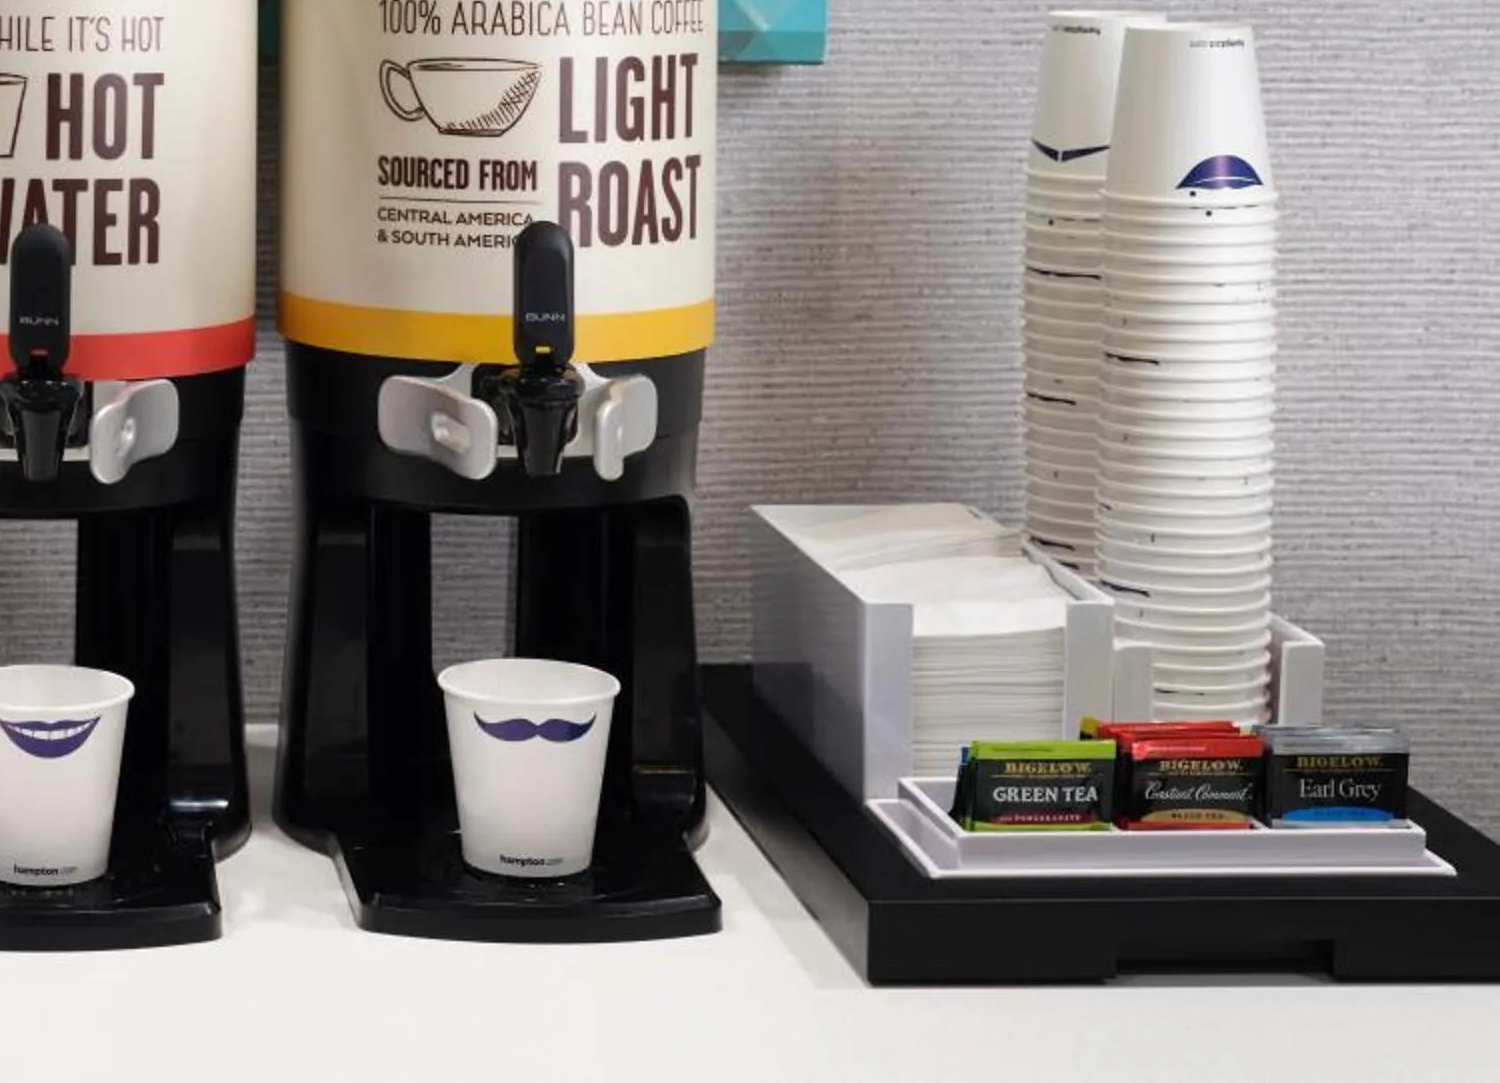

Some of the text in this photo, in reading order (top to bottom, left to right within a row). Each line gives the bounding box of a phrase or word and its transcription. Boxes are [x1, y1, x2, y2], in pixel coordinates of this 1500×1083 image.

[451, 0, 570, 37] ARABICA
[582, 0, 643, 36] BEAN
[68, 15, 111, 53] IT'S
[121, 15, 165, 53] HOT
[558, 52, 698, 143] LIGHT
[45, 72, 165, 160] HOT
[377, 154, 537, 192] SOURCED FROM
[557, 154, 701, 248] ROAST
[377, 207, 534, 227] CENTRAL AMERICA
[377, 228, 389, 244] &
[391, 229, 450, 247] SOUTH
[524, 312, 566, 323] BUNN
[1004, 761, 1092, 775] BIGELOW
[1159, 760, 1244, 771] BIGELOW
[991, 785, 1099, 803] GREEN TEA
[1300, 778, 1381, 803] Earl Grey
